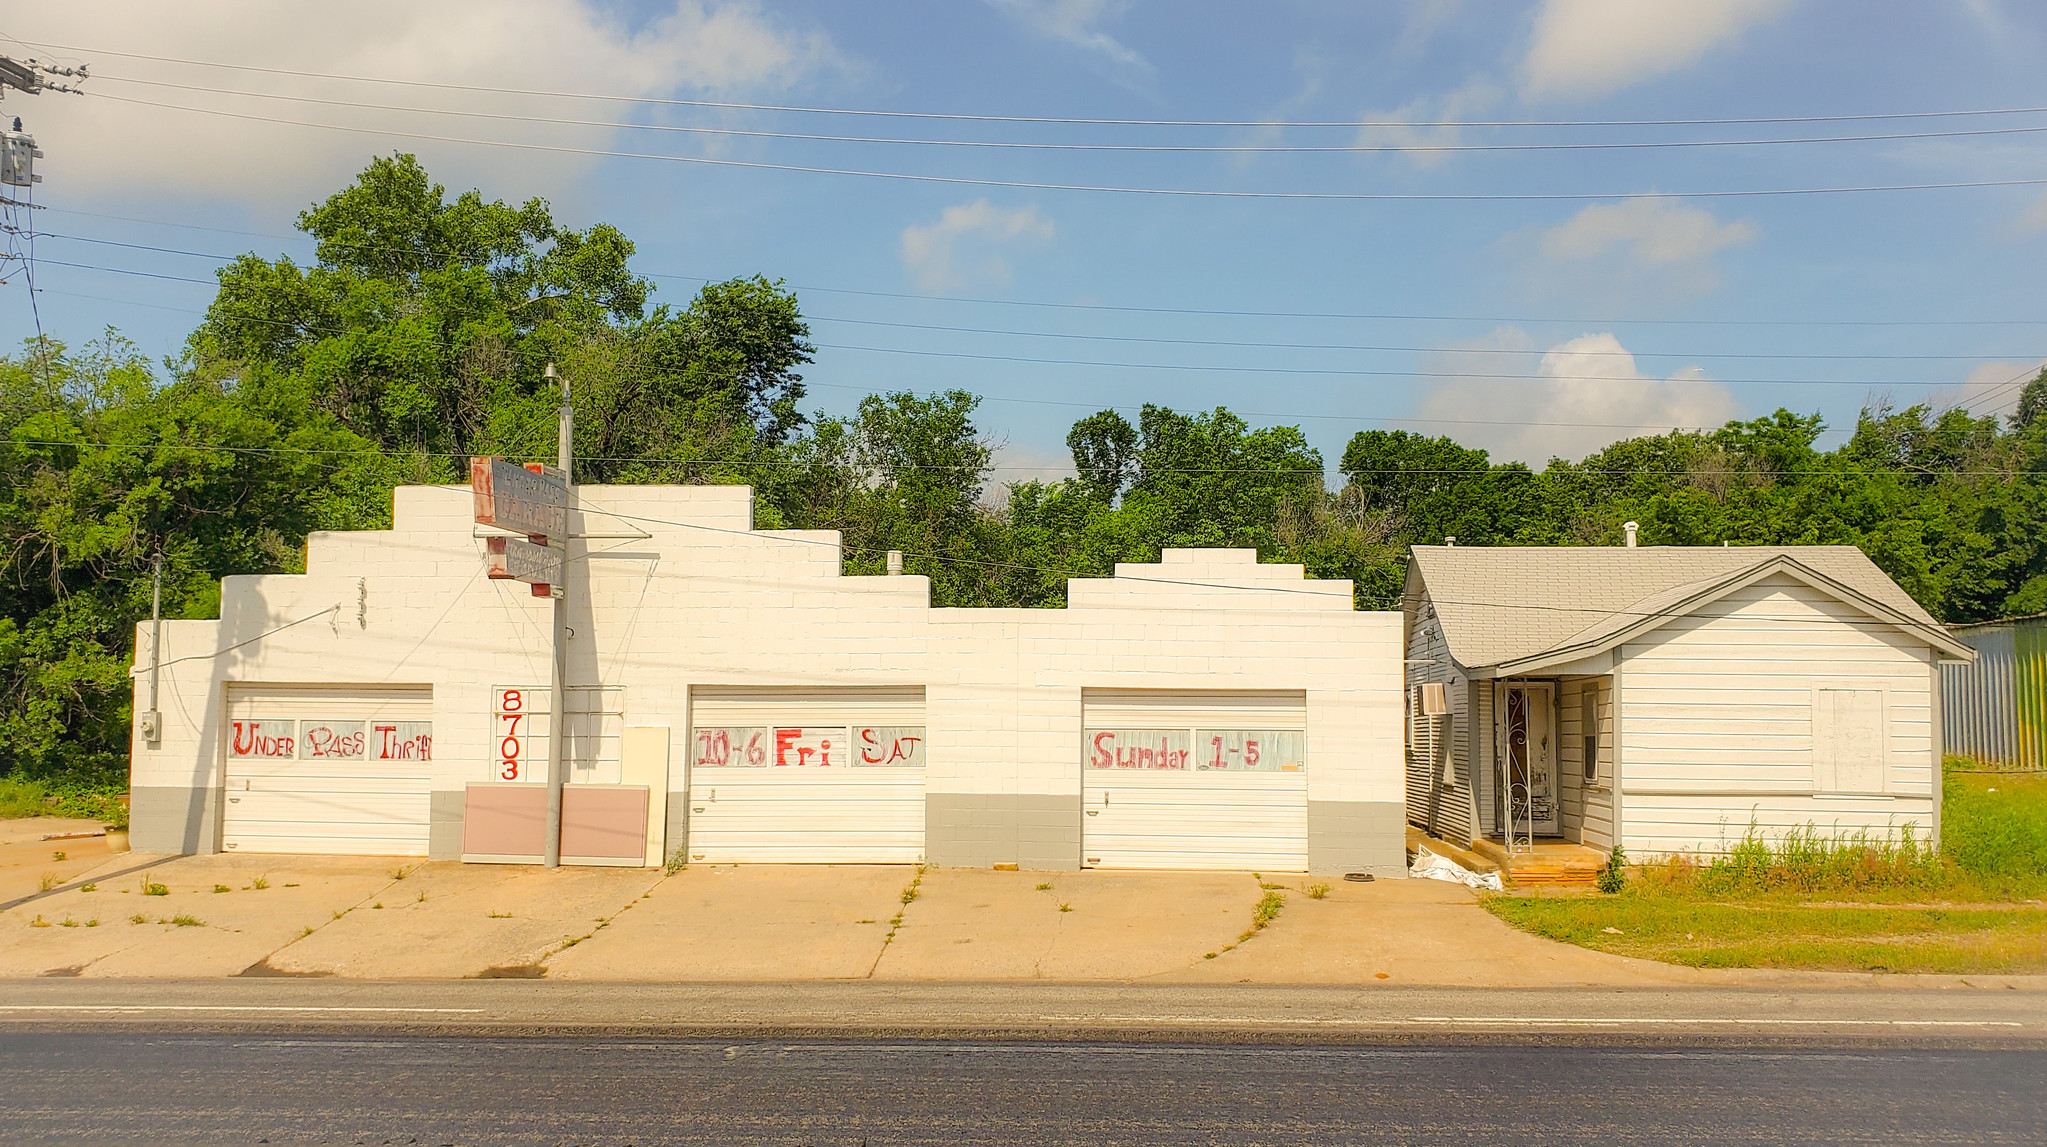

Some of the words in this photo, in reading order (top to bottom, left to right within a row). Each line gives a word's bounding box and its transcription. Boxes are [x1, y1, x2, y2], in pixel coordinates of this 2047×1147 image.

[501, 689, 522, 780] 8703
[698, 729, 765, 766] 10-6
[775, 729, 832, 767] Fri
[1091, 731, 1189, 769] Sunday
[1208, 735, 1261, 768] 1-5
